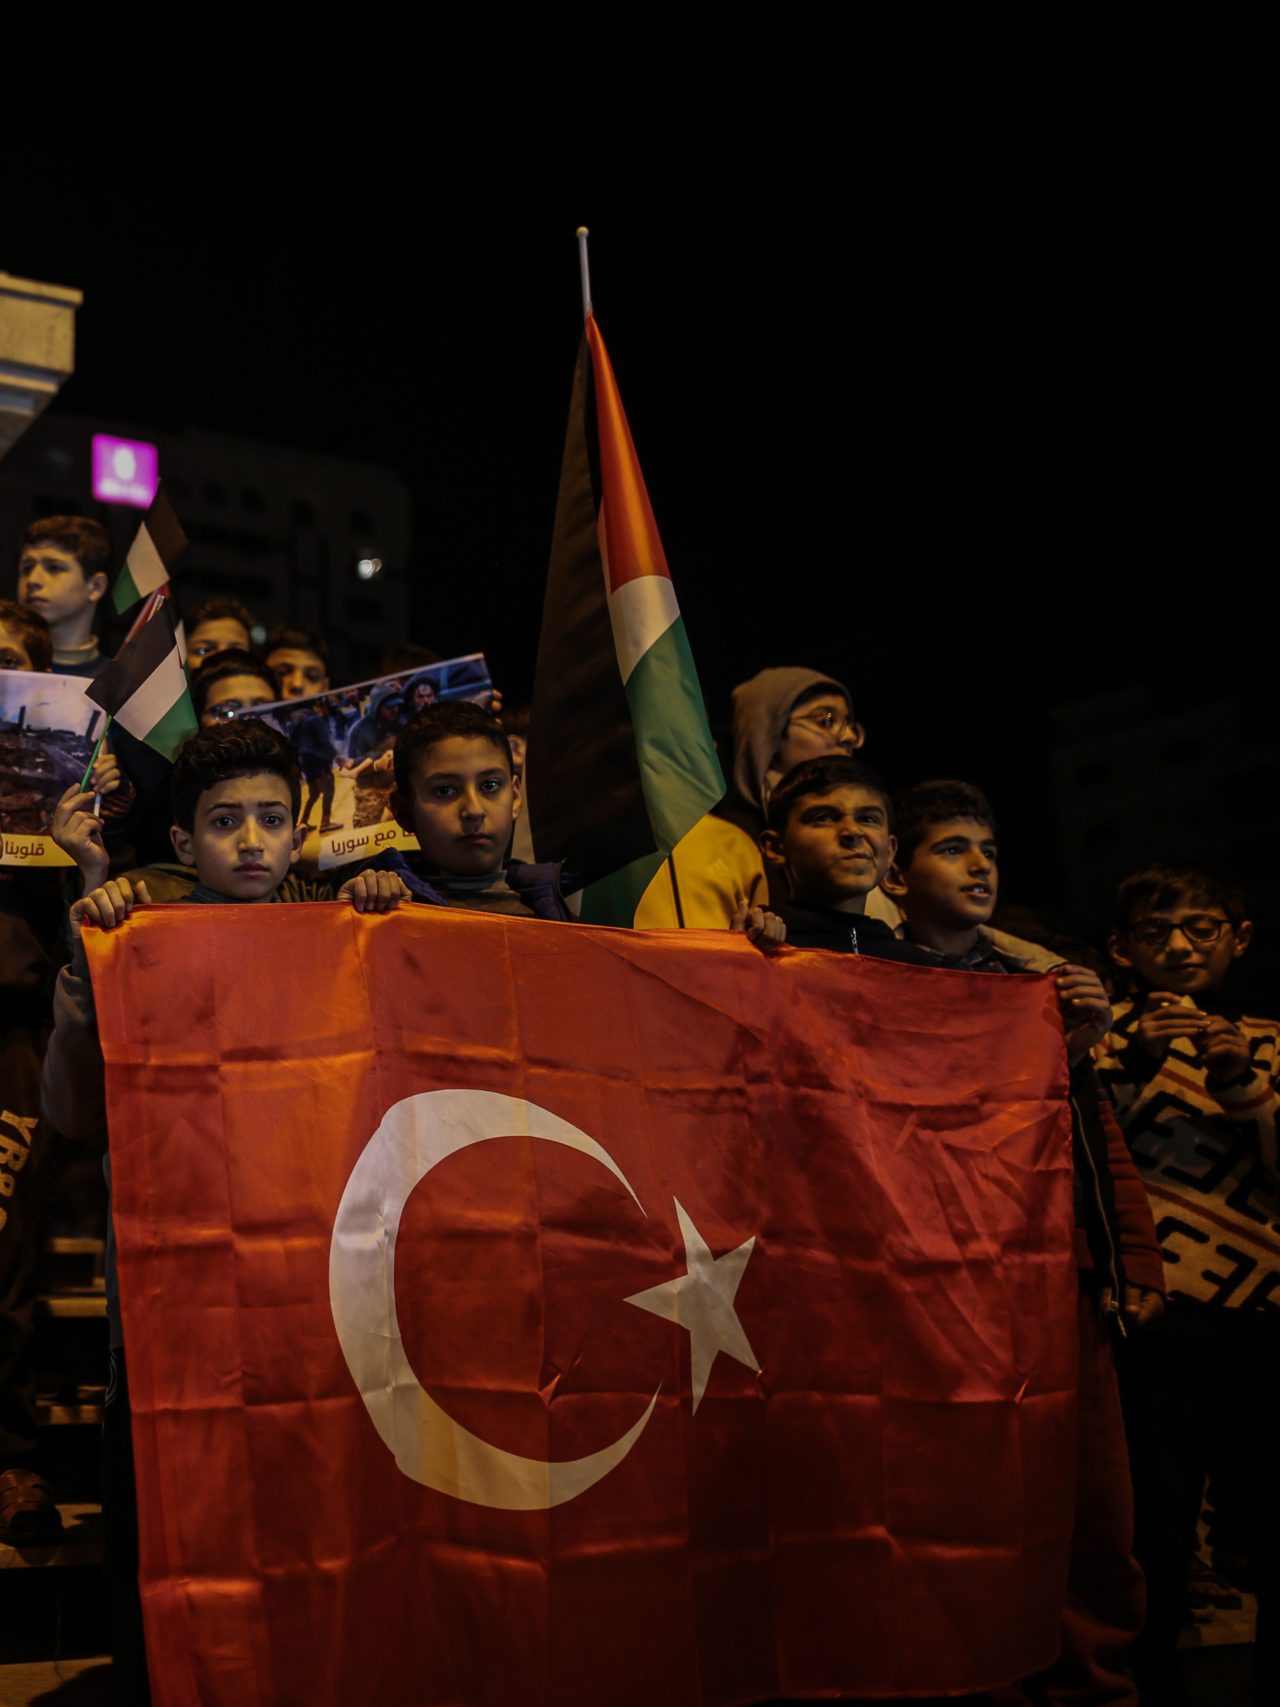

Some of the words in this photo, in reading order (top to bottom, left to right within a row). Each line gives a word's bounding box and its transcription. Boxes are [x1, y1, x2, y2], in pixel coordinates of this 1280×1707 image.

[330, 834, 370, 857] سوريا
[374, 829, 397, 847] مع
[4, 841, 45, 860] قلوبنا
